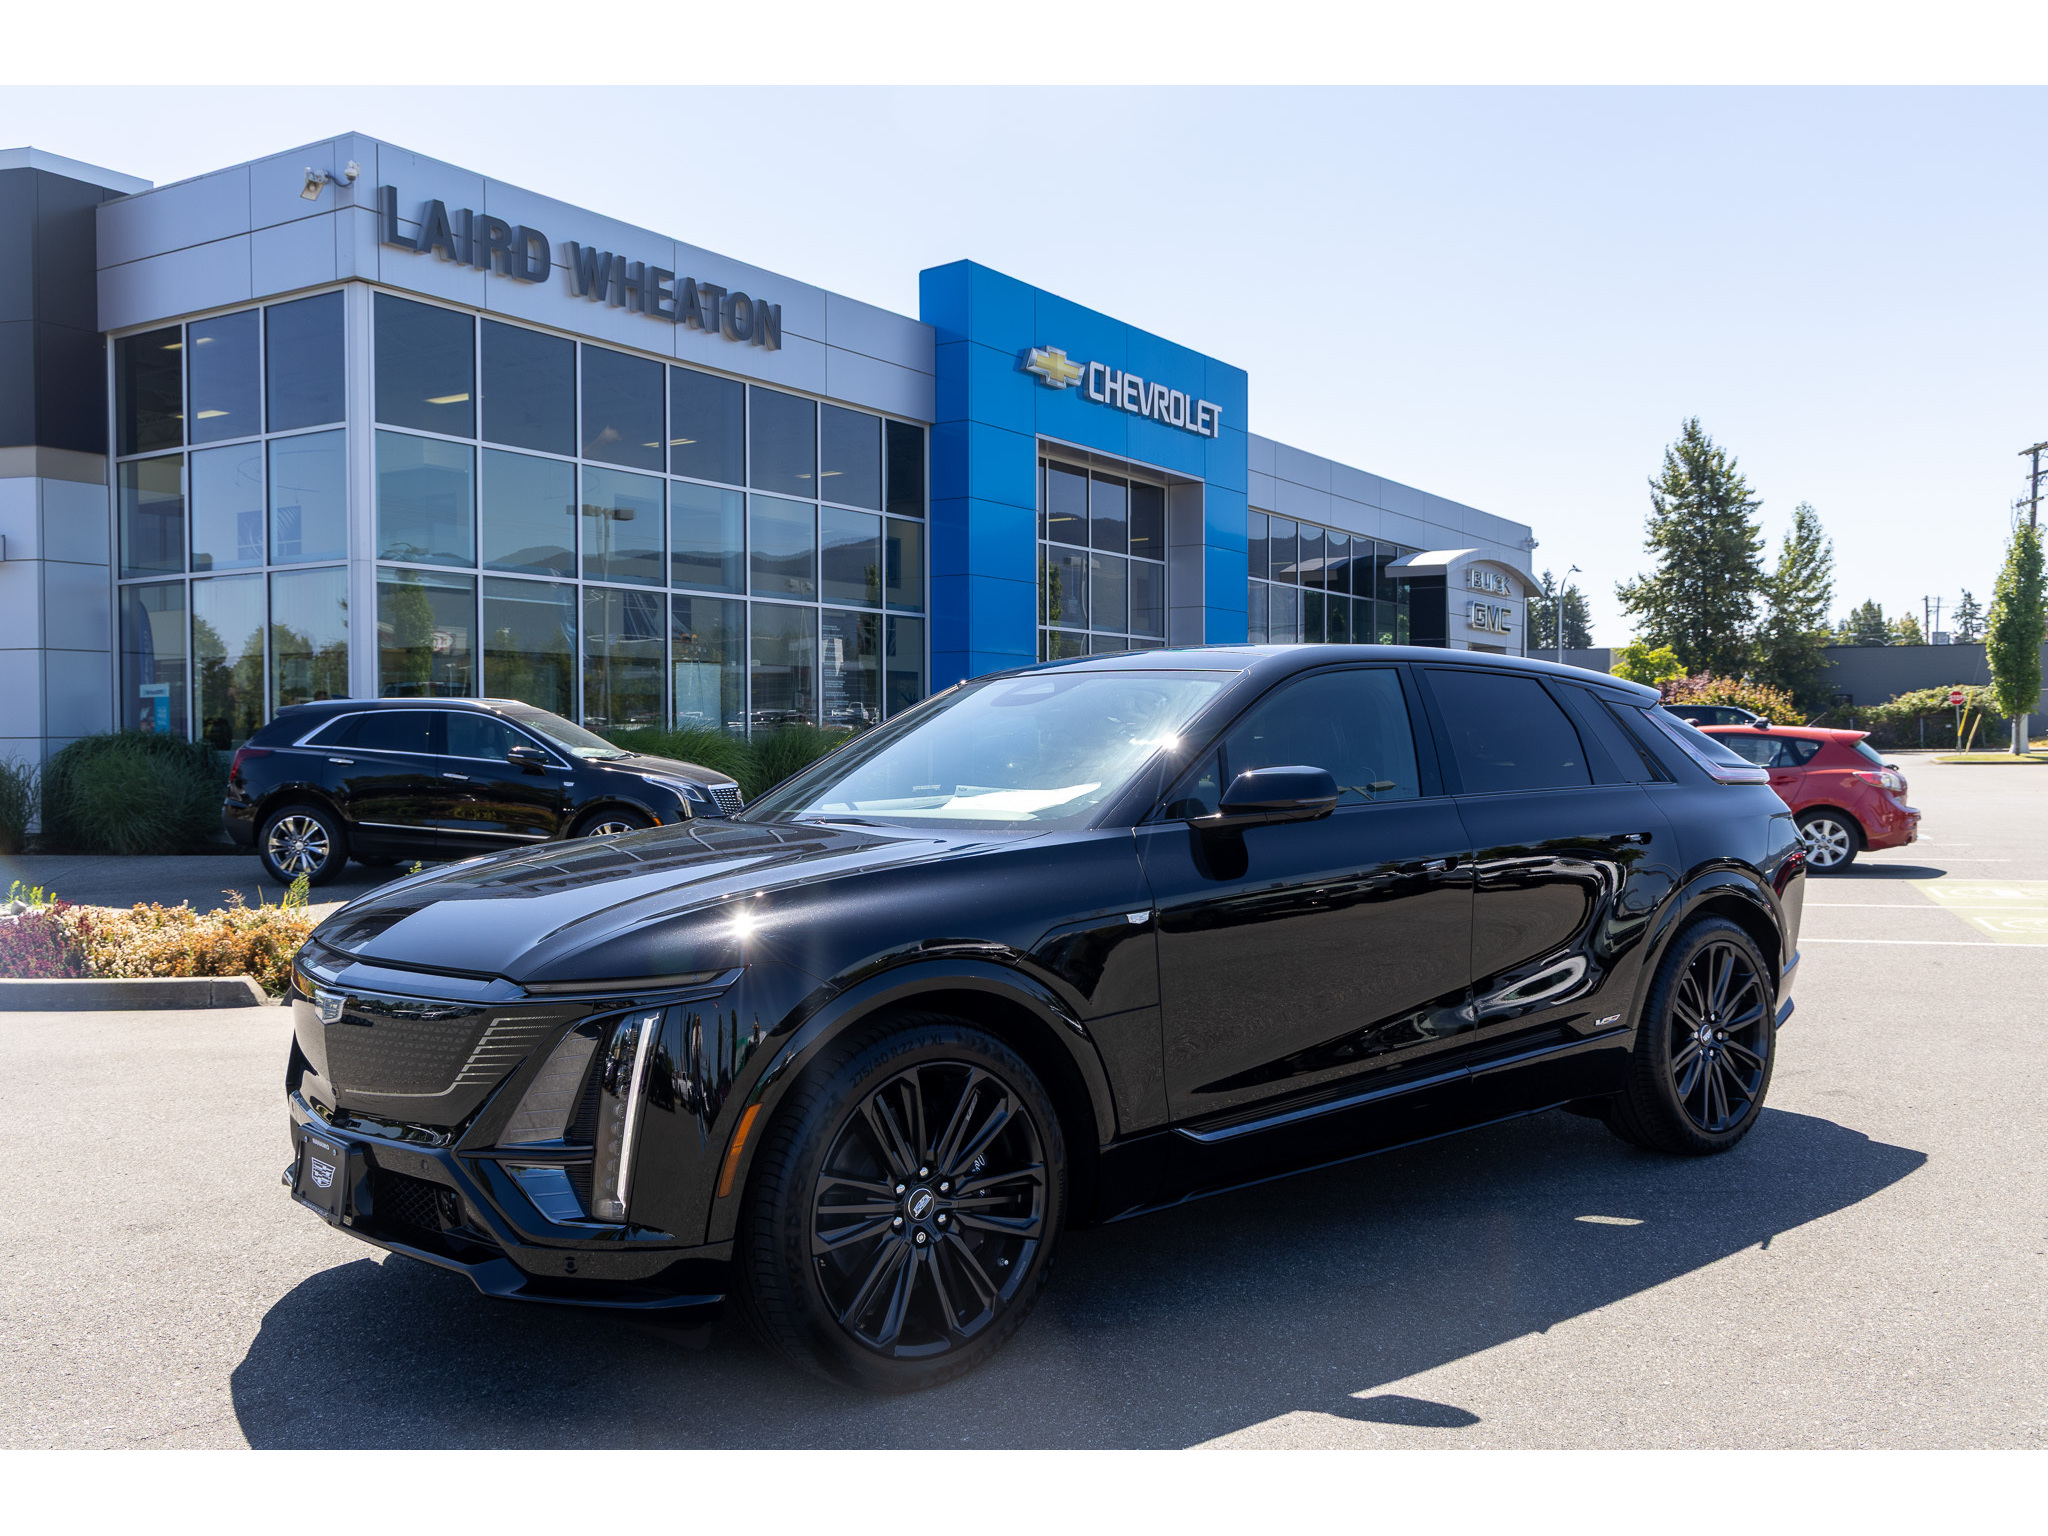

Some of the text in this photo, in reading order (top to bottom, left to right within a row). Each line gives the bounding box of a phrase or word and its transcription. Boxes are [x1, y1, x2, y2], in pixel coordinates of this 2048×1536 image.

[382, 185, 782, 351] LAIRD WHEATON
[1085, 360, 1222, 438] CHEVROLET
[1469, 568, 1511, 595] BUICK
[1469, 601, 1511, 633] GMC
[849, 1052, 889, 1088] 275/40
[929, 1034, 944, 1045] XL
